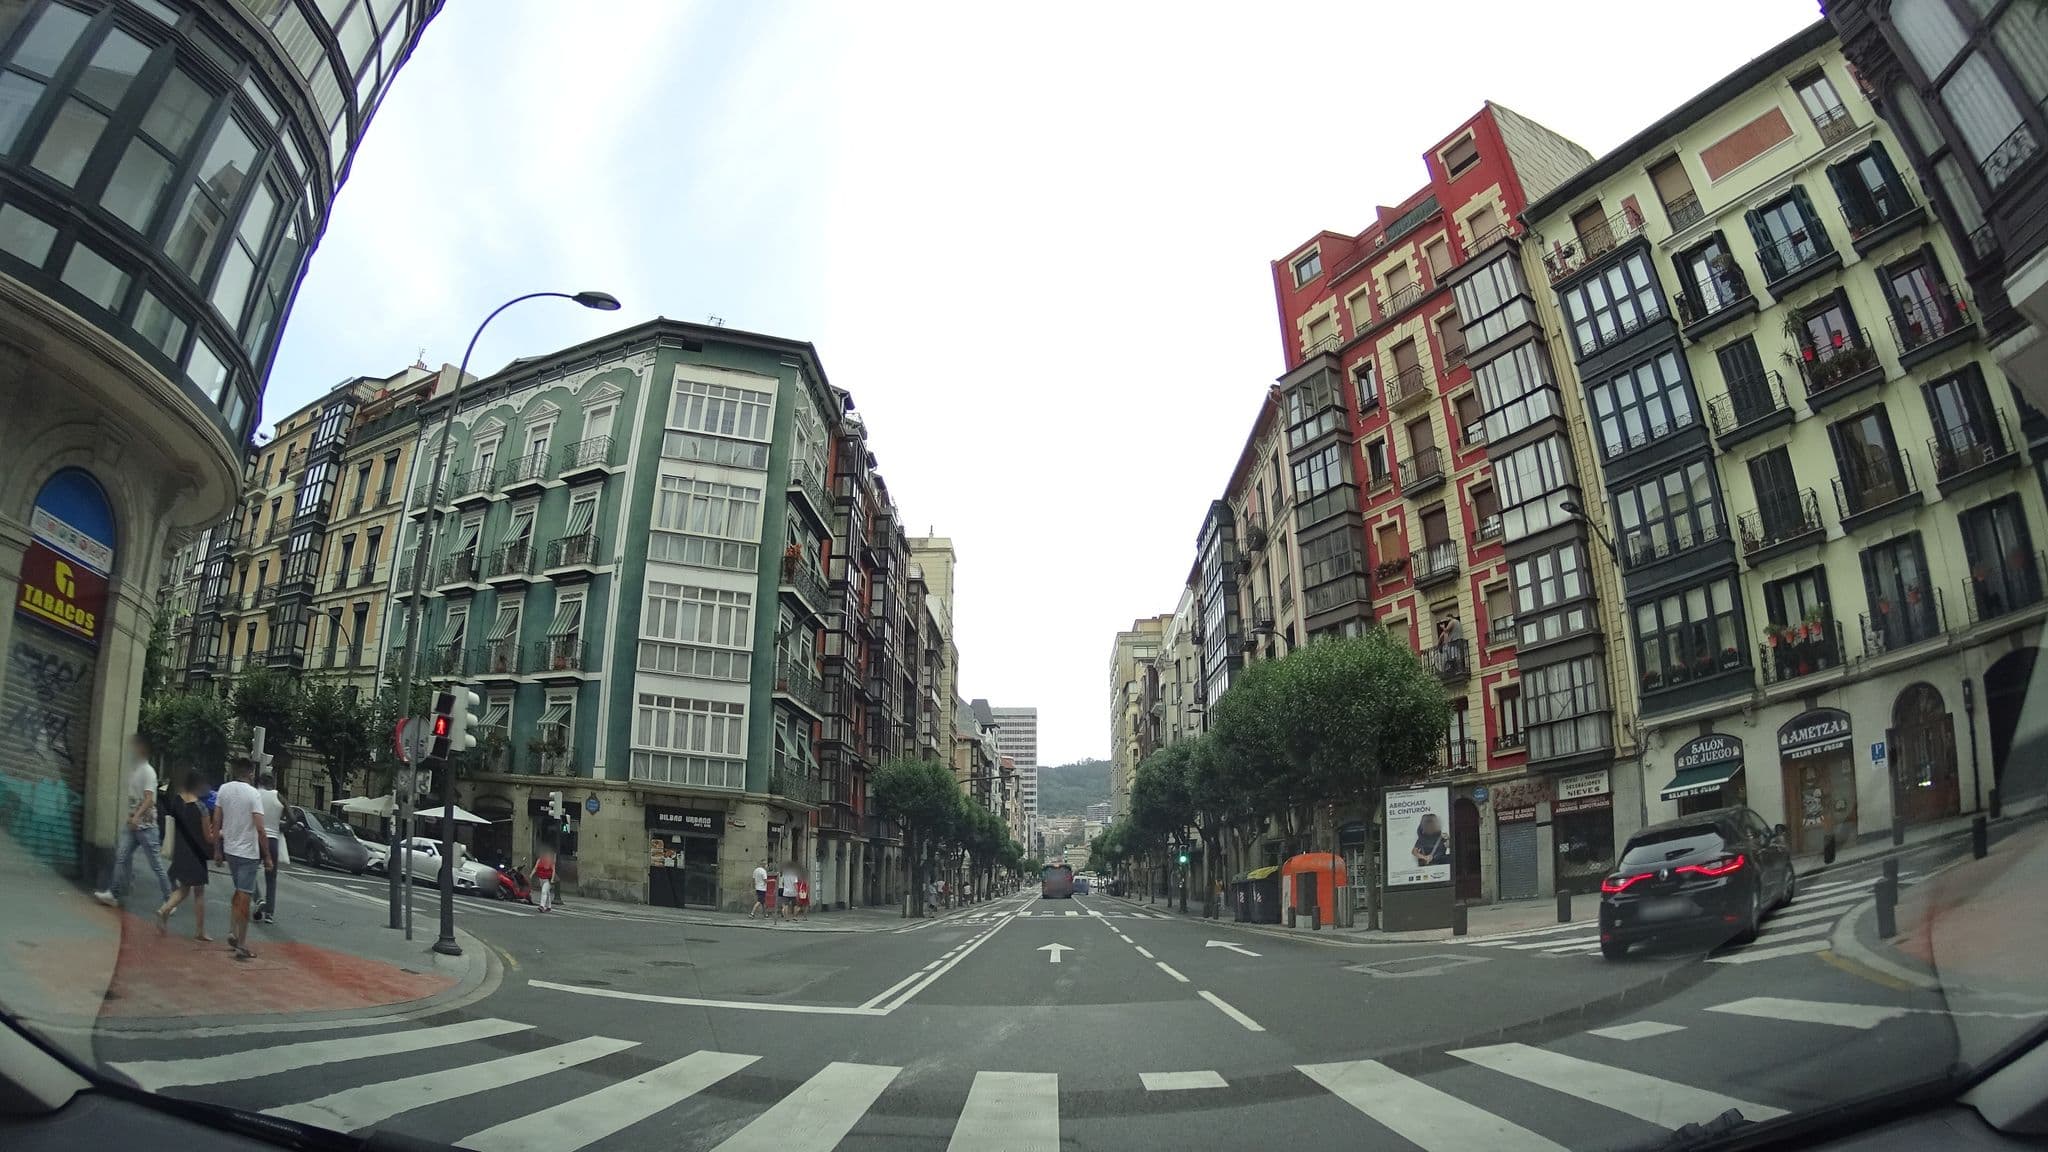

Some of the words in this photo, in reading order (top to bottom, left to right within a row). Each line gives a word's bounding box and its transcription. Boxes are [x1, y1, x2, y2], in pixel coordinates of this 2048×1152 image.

[24, 584, 95, 630] TABACOS
[1789, 720, 1840, 744] AMETZA
[1691, 739, 1724, 755] SALÓN
[1685, 755, 1699, 766] DE
[1700, 747, 1732, 763] JUEGO
[1567, 785, 1601, 797] NIEVES
[659, 813, 683, 822] BILBAO
[685, 815, 711, 824] URBANO
[1397, 806, 1431, 815] CINTURÓN
